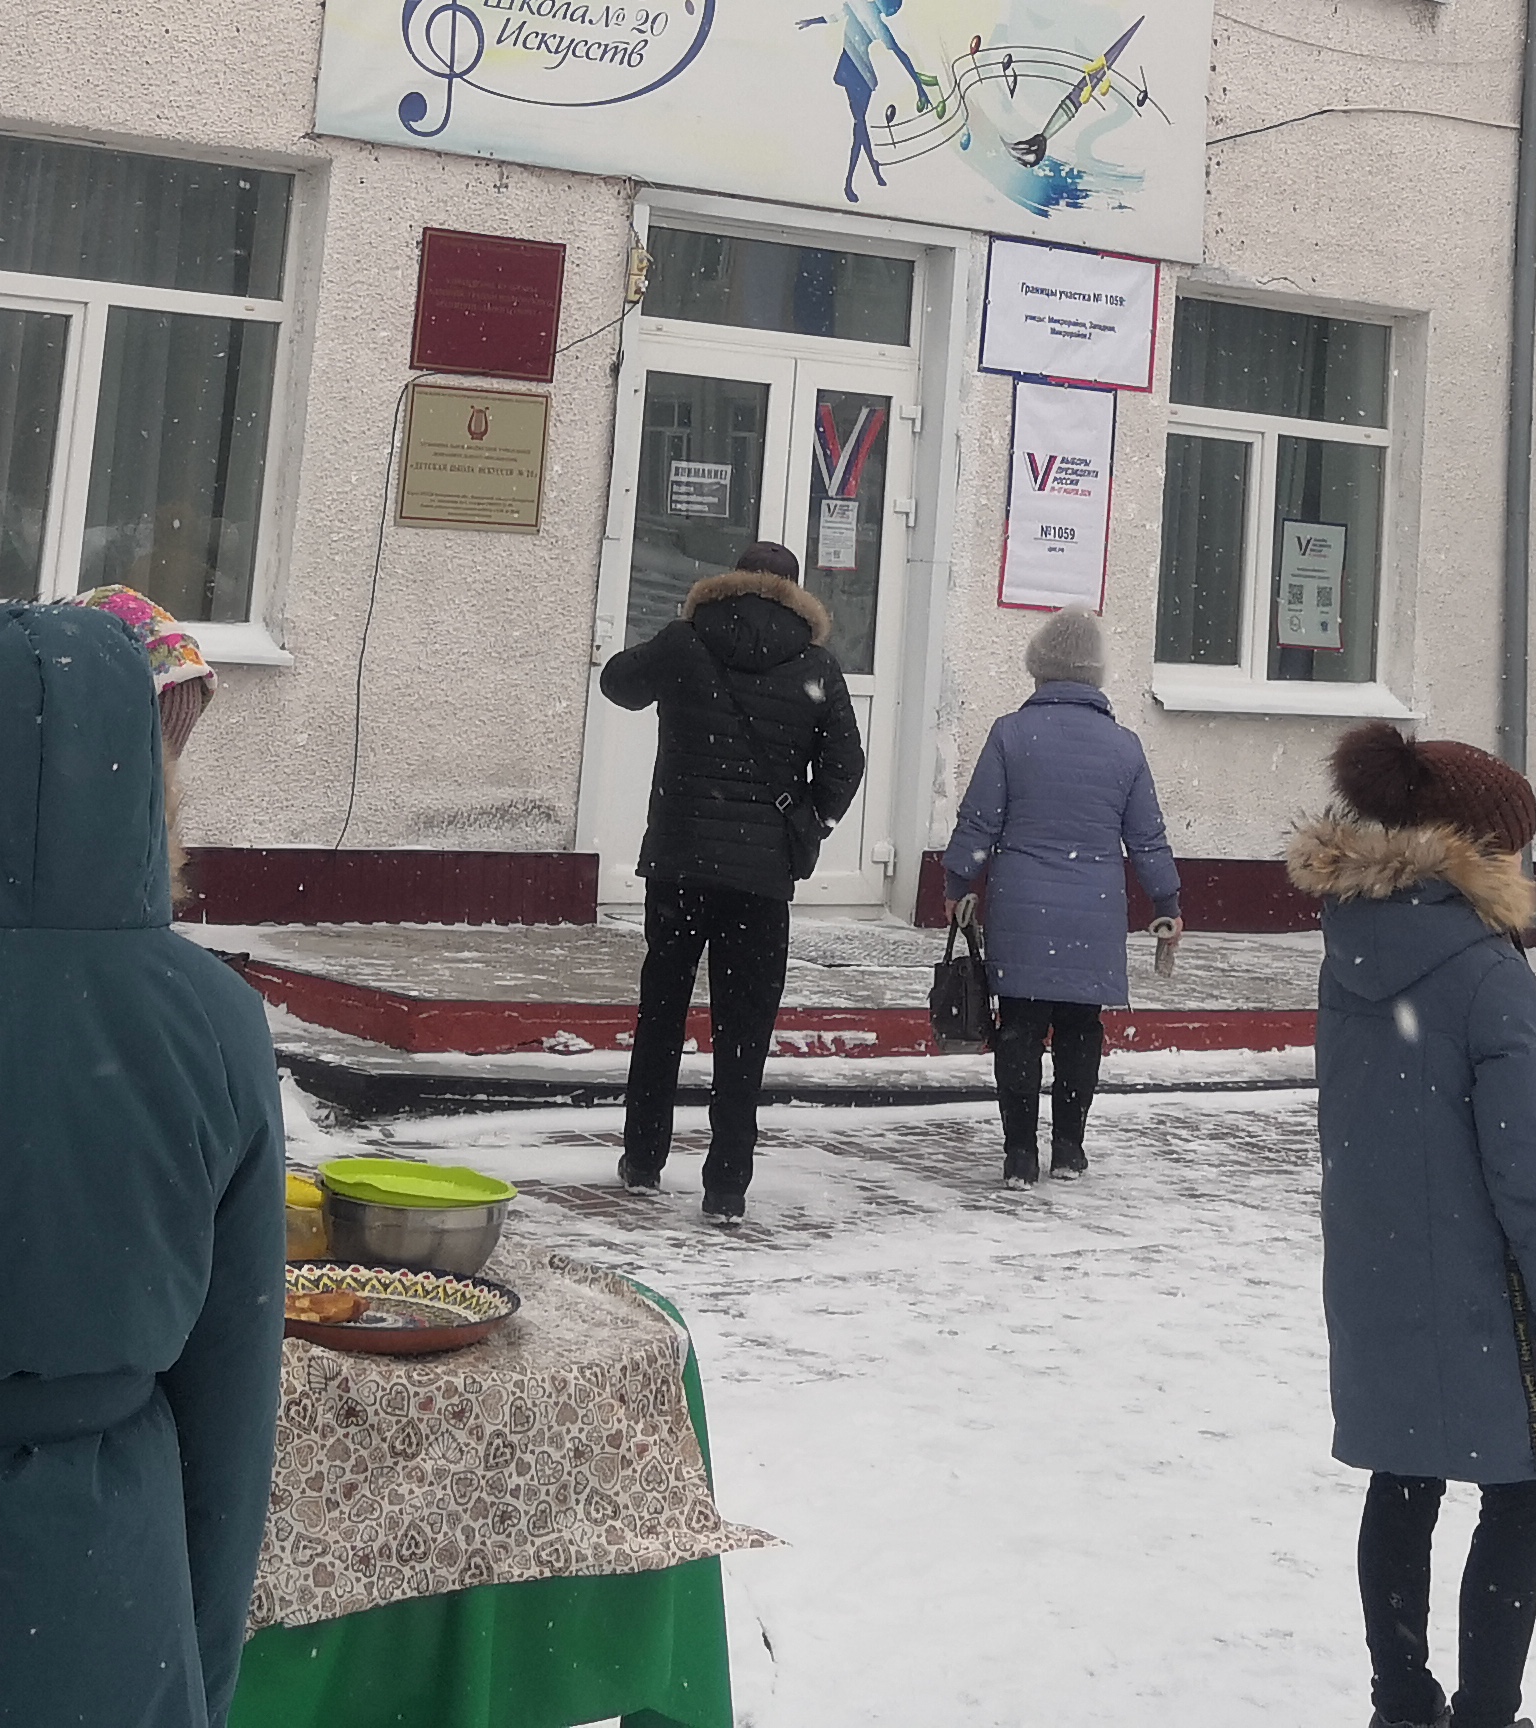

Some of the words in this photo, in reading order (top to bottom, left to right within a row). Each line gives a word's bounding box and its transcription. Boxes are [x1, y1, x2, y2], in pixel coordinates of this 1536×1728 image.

[588, 5, 626, 28] №
[630, 9, 669, 37] 20
[496, 17, 649, 70] Искусств
[1020, 282, 1058, 298] Границы
[1058, 290, 1092, 303] участка
